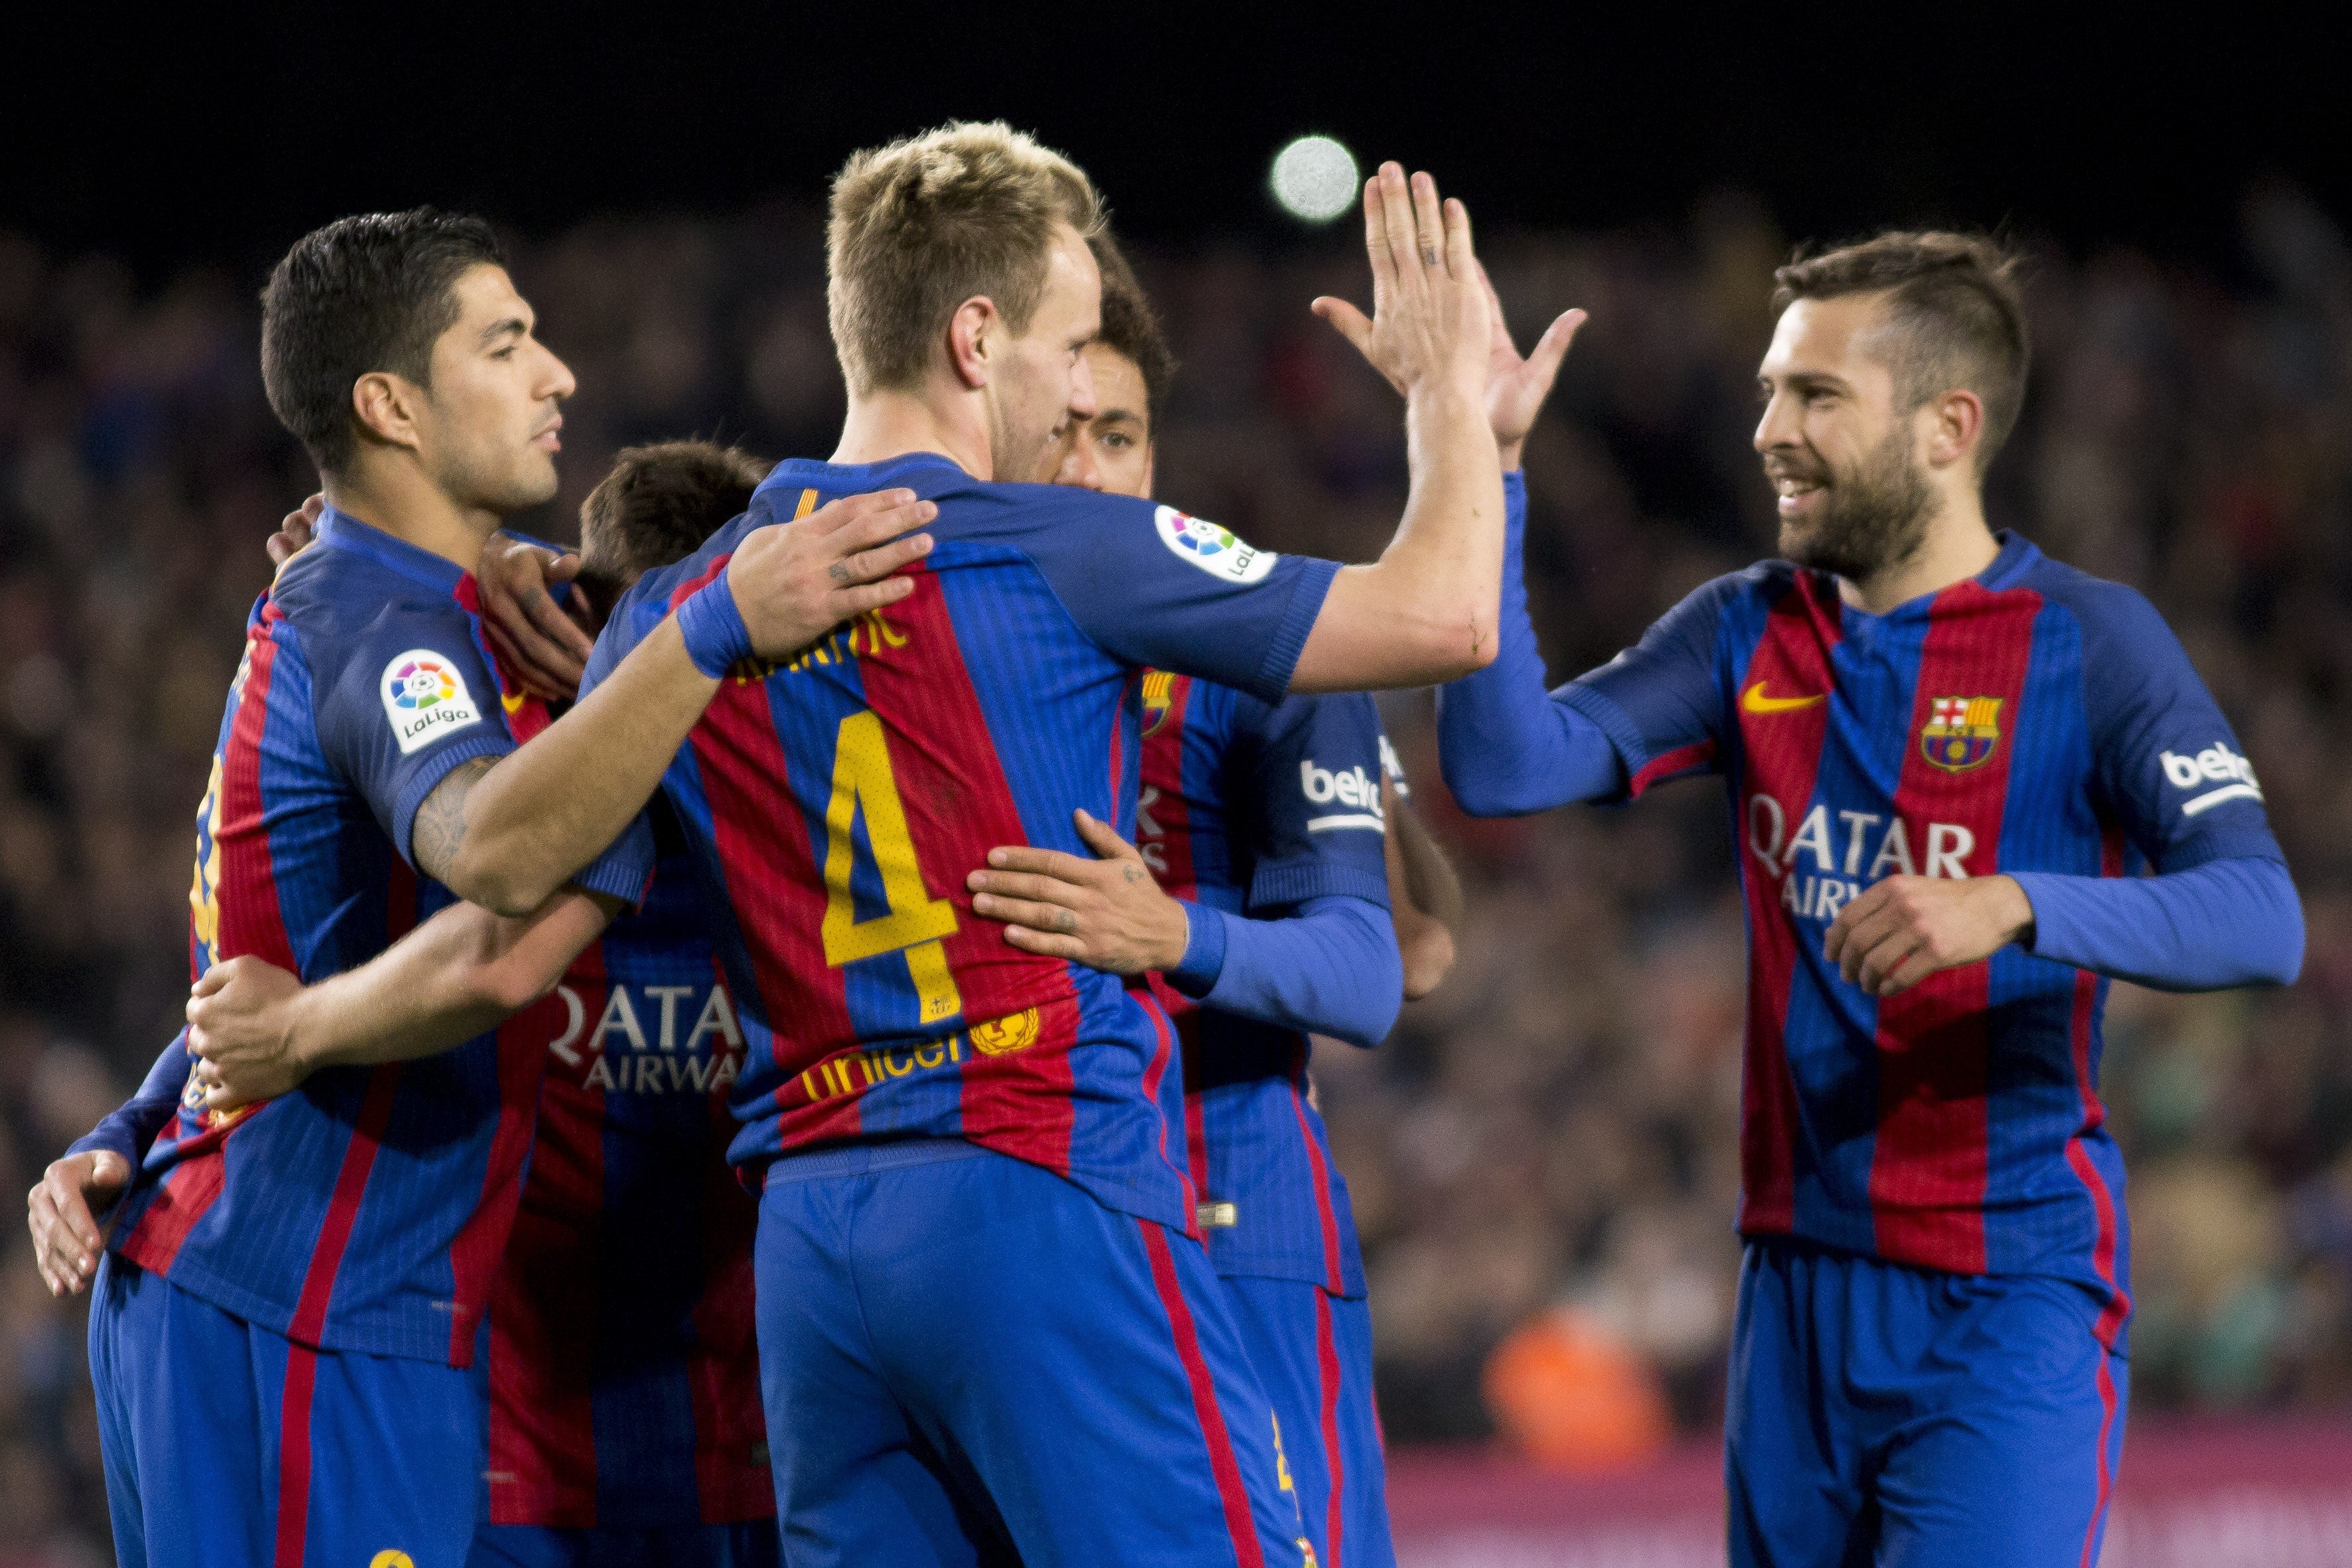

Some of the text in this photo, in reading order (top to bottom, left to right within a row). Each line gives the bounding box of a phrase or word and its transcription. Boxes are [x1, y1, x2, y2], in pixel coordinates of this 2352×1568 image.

[404, 708, 469, 739] LaLiga
[821, 708, 960, 1024] 4
[1748, 793, 1976, 880] QATAR
[548, 983, 742, 1067] QATA
[582, 1053, 738, 1094] AIRWA
